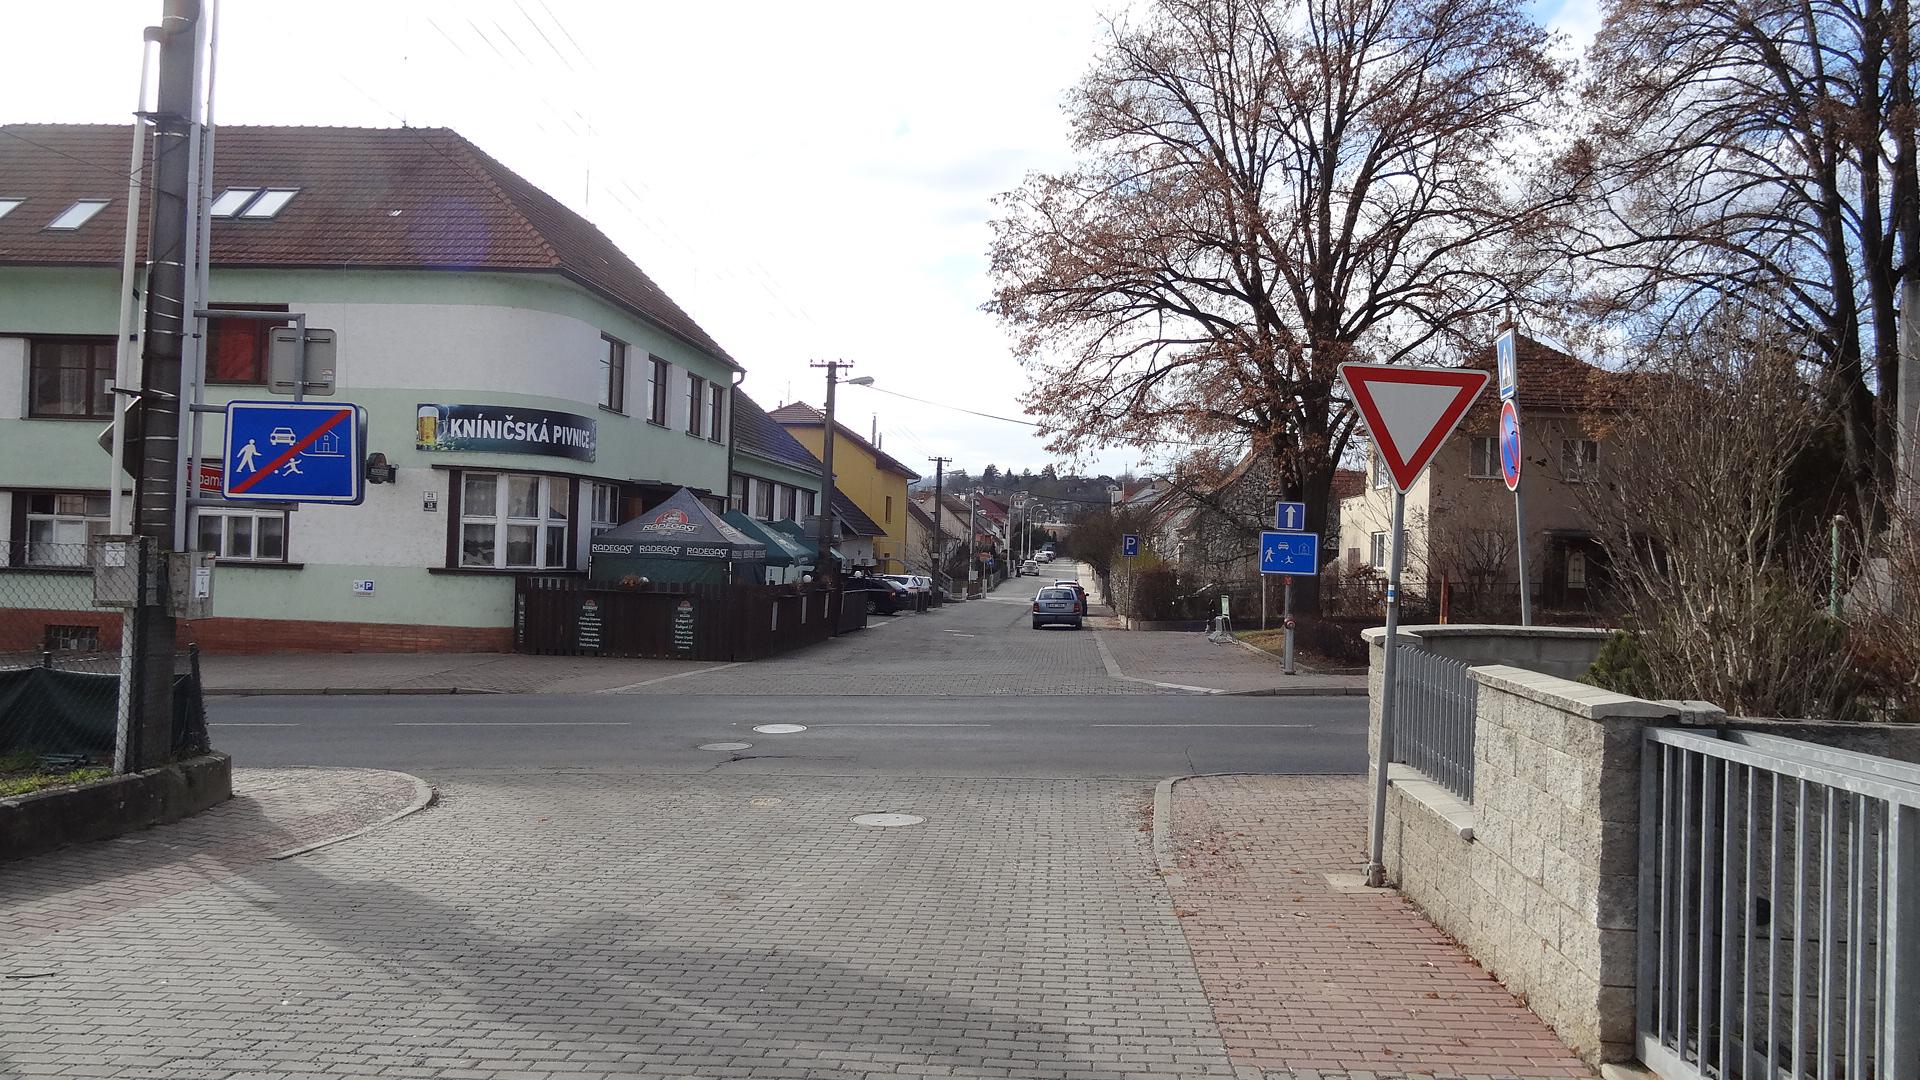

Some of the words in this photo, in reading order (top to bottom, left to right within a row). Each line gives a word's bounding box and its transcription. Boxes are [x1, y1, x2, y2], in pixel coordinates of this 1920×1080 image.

[450, 413, 550, 443] KNÍNIČSKÁ
[552, 425, 590, 449] PIVNICE
[642, 523, 696, 534] RADEGAST
[1126, 537, 1136, 550] P
[592, 544, 634, 554] RADEGAST
[639, 545, 682, 556] RADEGAST
[686, 547, 729, 558] RADEGAST
